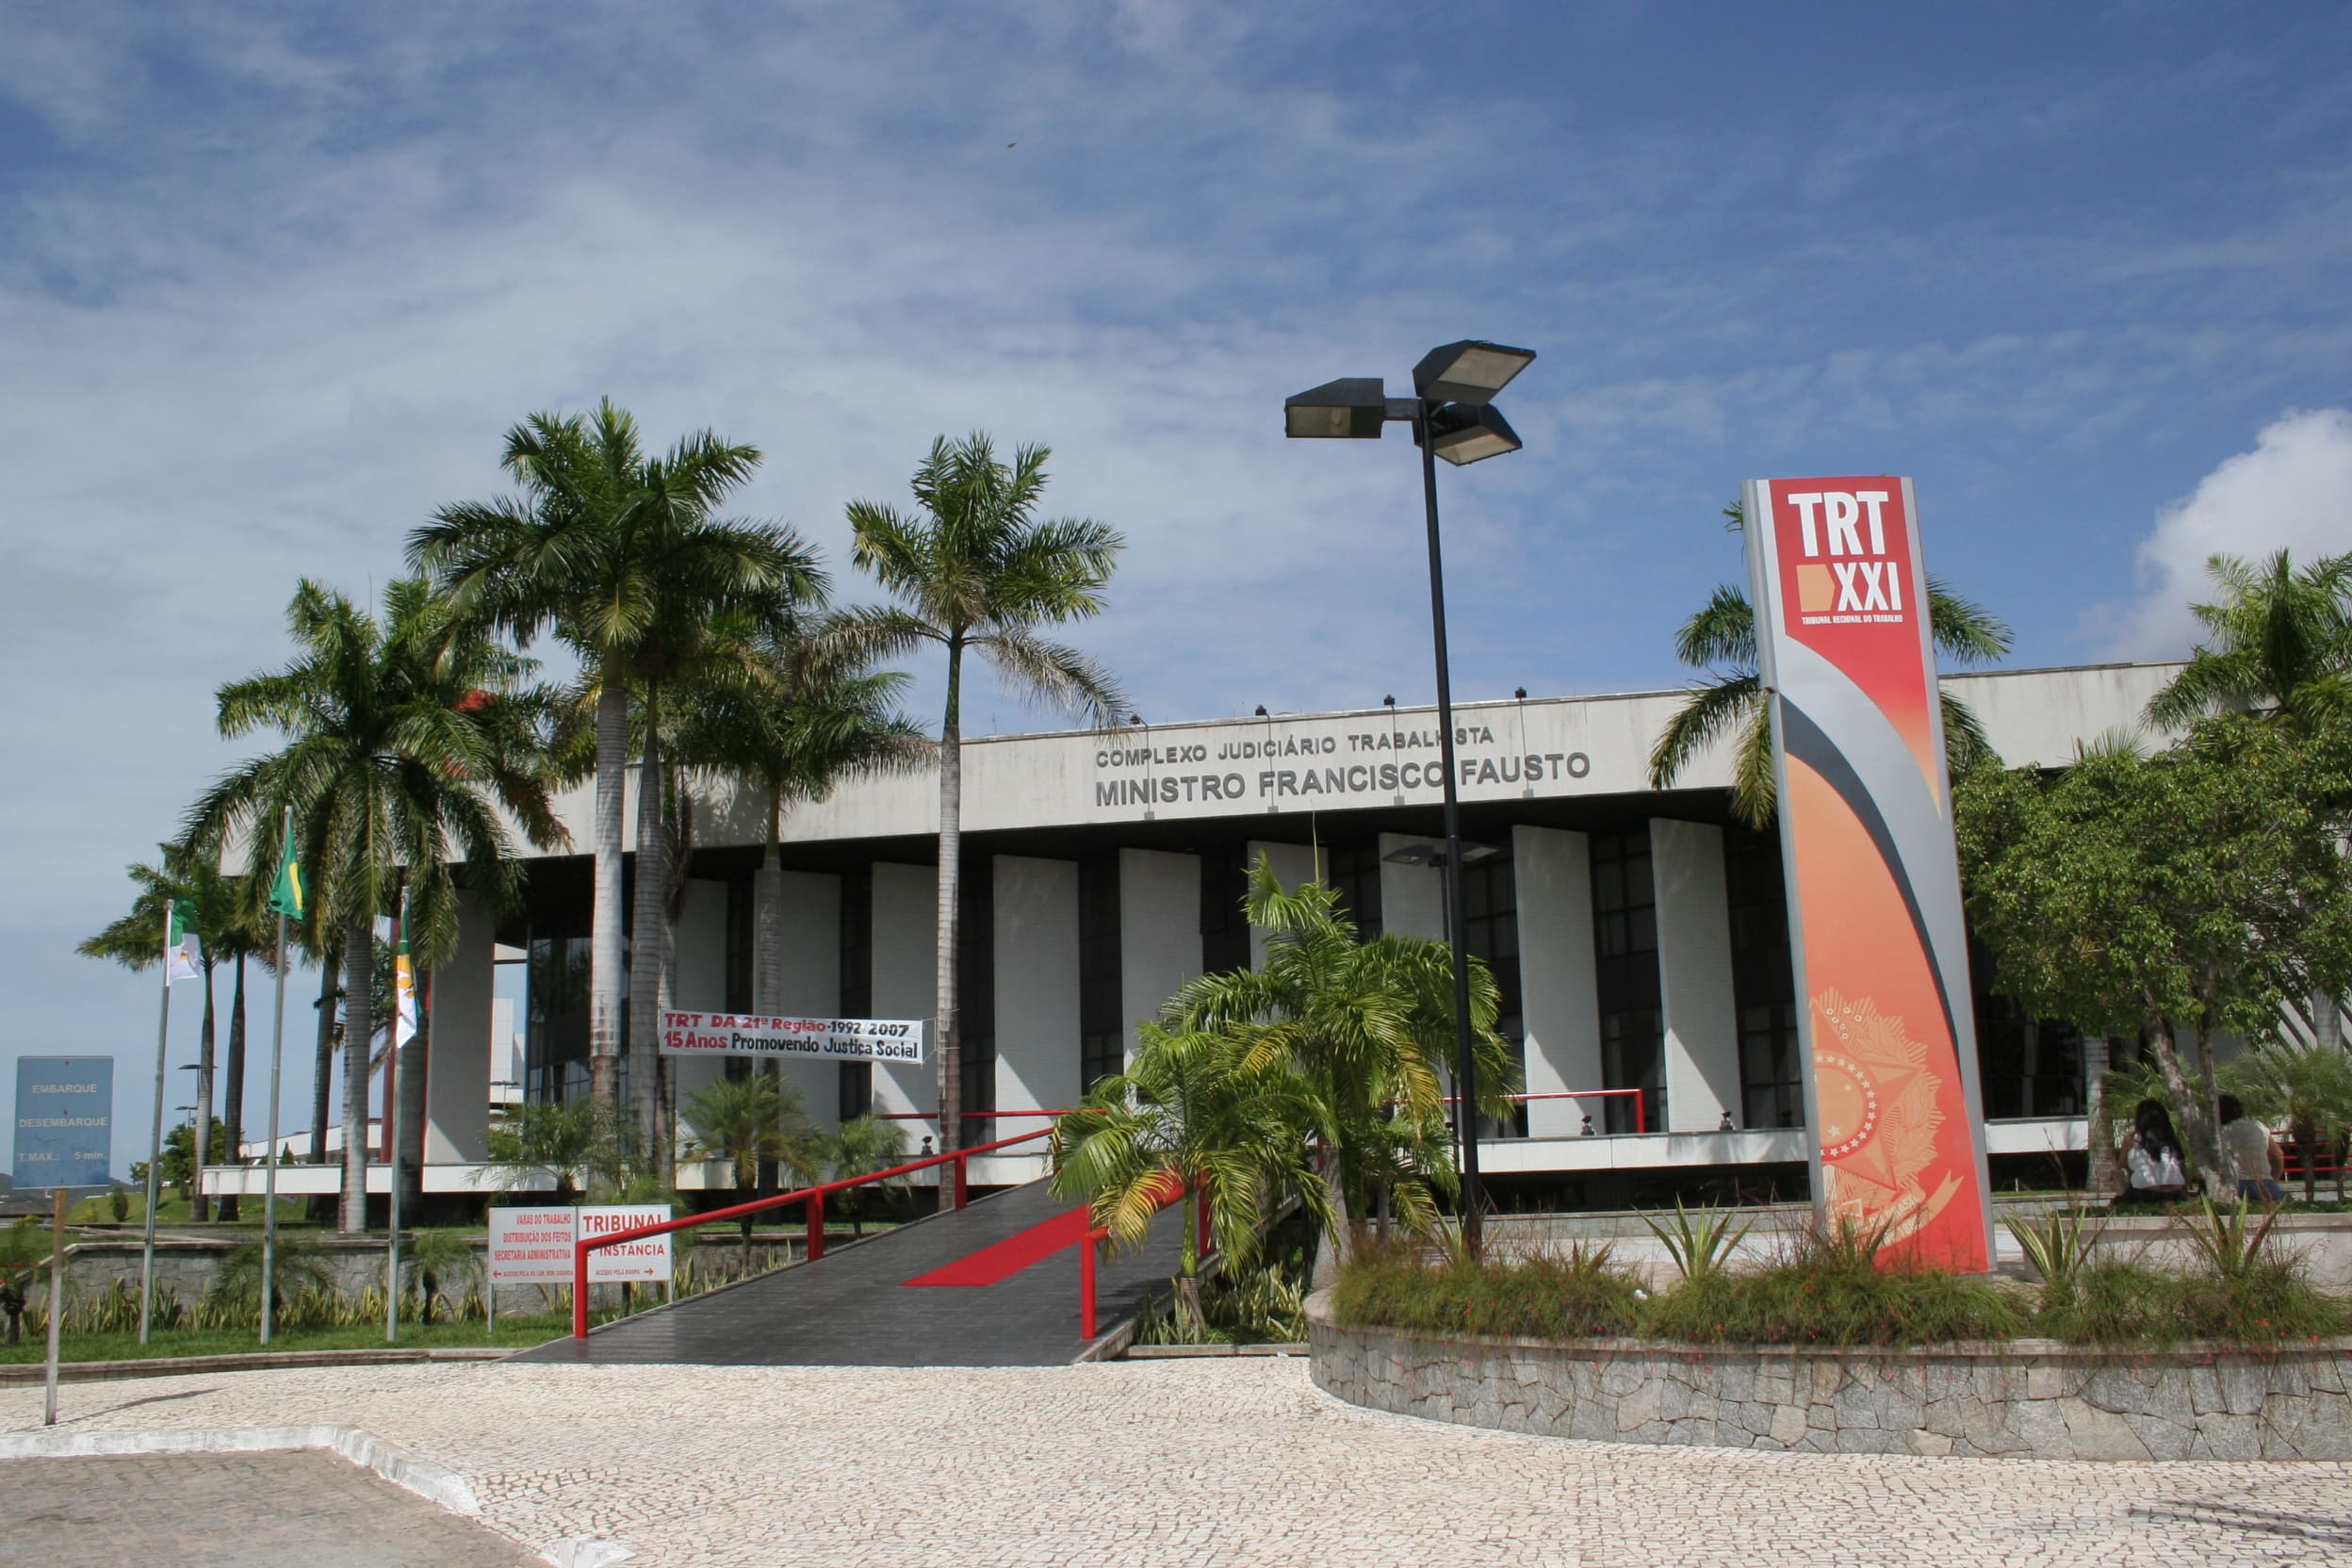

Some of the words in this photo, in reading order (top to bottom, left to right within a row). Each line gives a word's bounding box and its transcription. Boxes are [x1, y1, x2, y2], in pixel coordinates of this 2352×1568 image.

[1788, 491, 1889, 557] TRT
[1833, 562, 1902, 612] XXI
[1802, 616, 1832, 625] TRIBUNAL
[1833, 615, 1862, 624] REGIONAL
[1863, 614, 1872, 623] DO
[1873, 614, 1903, 623] TRABALHO
[1096, 744, 1207, 767] COMPLEXO
[1217, 735, 1336, 760] JUDICIÁRIO
[1348, 727, 1494, 752] TRABALHSTA
[1096, 773, 1246, 807] MINISTRO
[1259, 761, 1444, 797] FRANCISCO
[1461, 752, 1591, 786] FAUSTO
[664, 1013, 702, 1027] TRT
[711, 1015, 735, 1028] DA
[868, 1023, 909, 1037] 2007
[664, 1031, 683, 1048] 15
[685, 1031, 727, 1049] Anos
[731, 1033, 819, 1053] Promovendo
[825, 1037, 873, 1055] Justiça
[876, 1040, 918, 1058] Social
[32, 1084, 97, 1094] EMBARQUE
[19, 1117, 107, 1128] DESEMBARQUE
[74, 1152, 82, 1161] 5
[516, 1215, 532, 1225] VARAS
[534, 1214, 542, 1225] DO
[543, 1213, 571, 1225] TRABALHO
[503, 1230, 539, 1245] DISTRIBUIÇÃO
[540, 1232, 551, 1243] DOS
[553, 1231, 571, 1243] FEITOS
[495, 1250, 525, 1262] SECRETARIA
[527, 1249, 571, 1261] ADMINISTRATIVA
[599, 1241, 664, 1257] INSTÂNCIA
